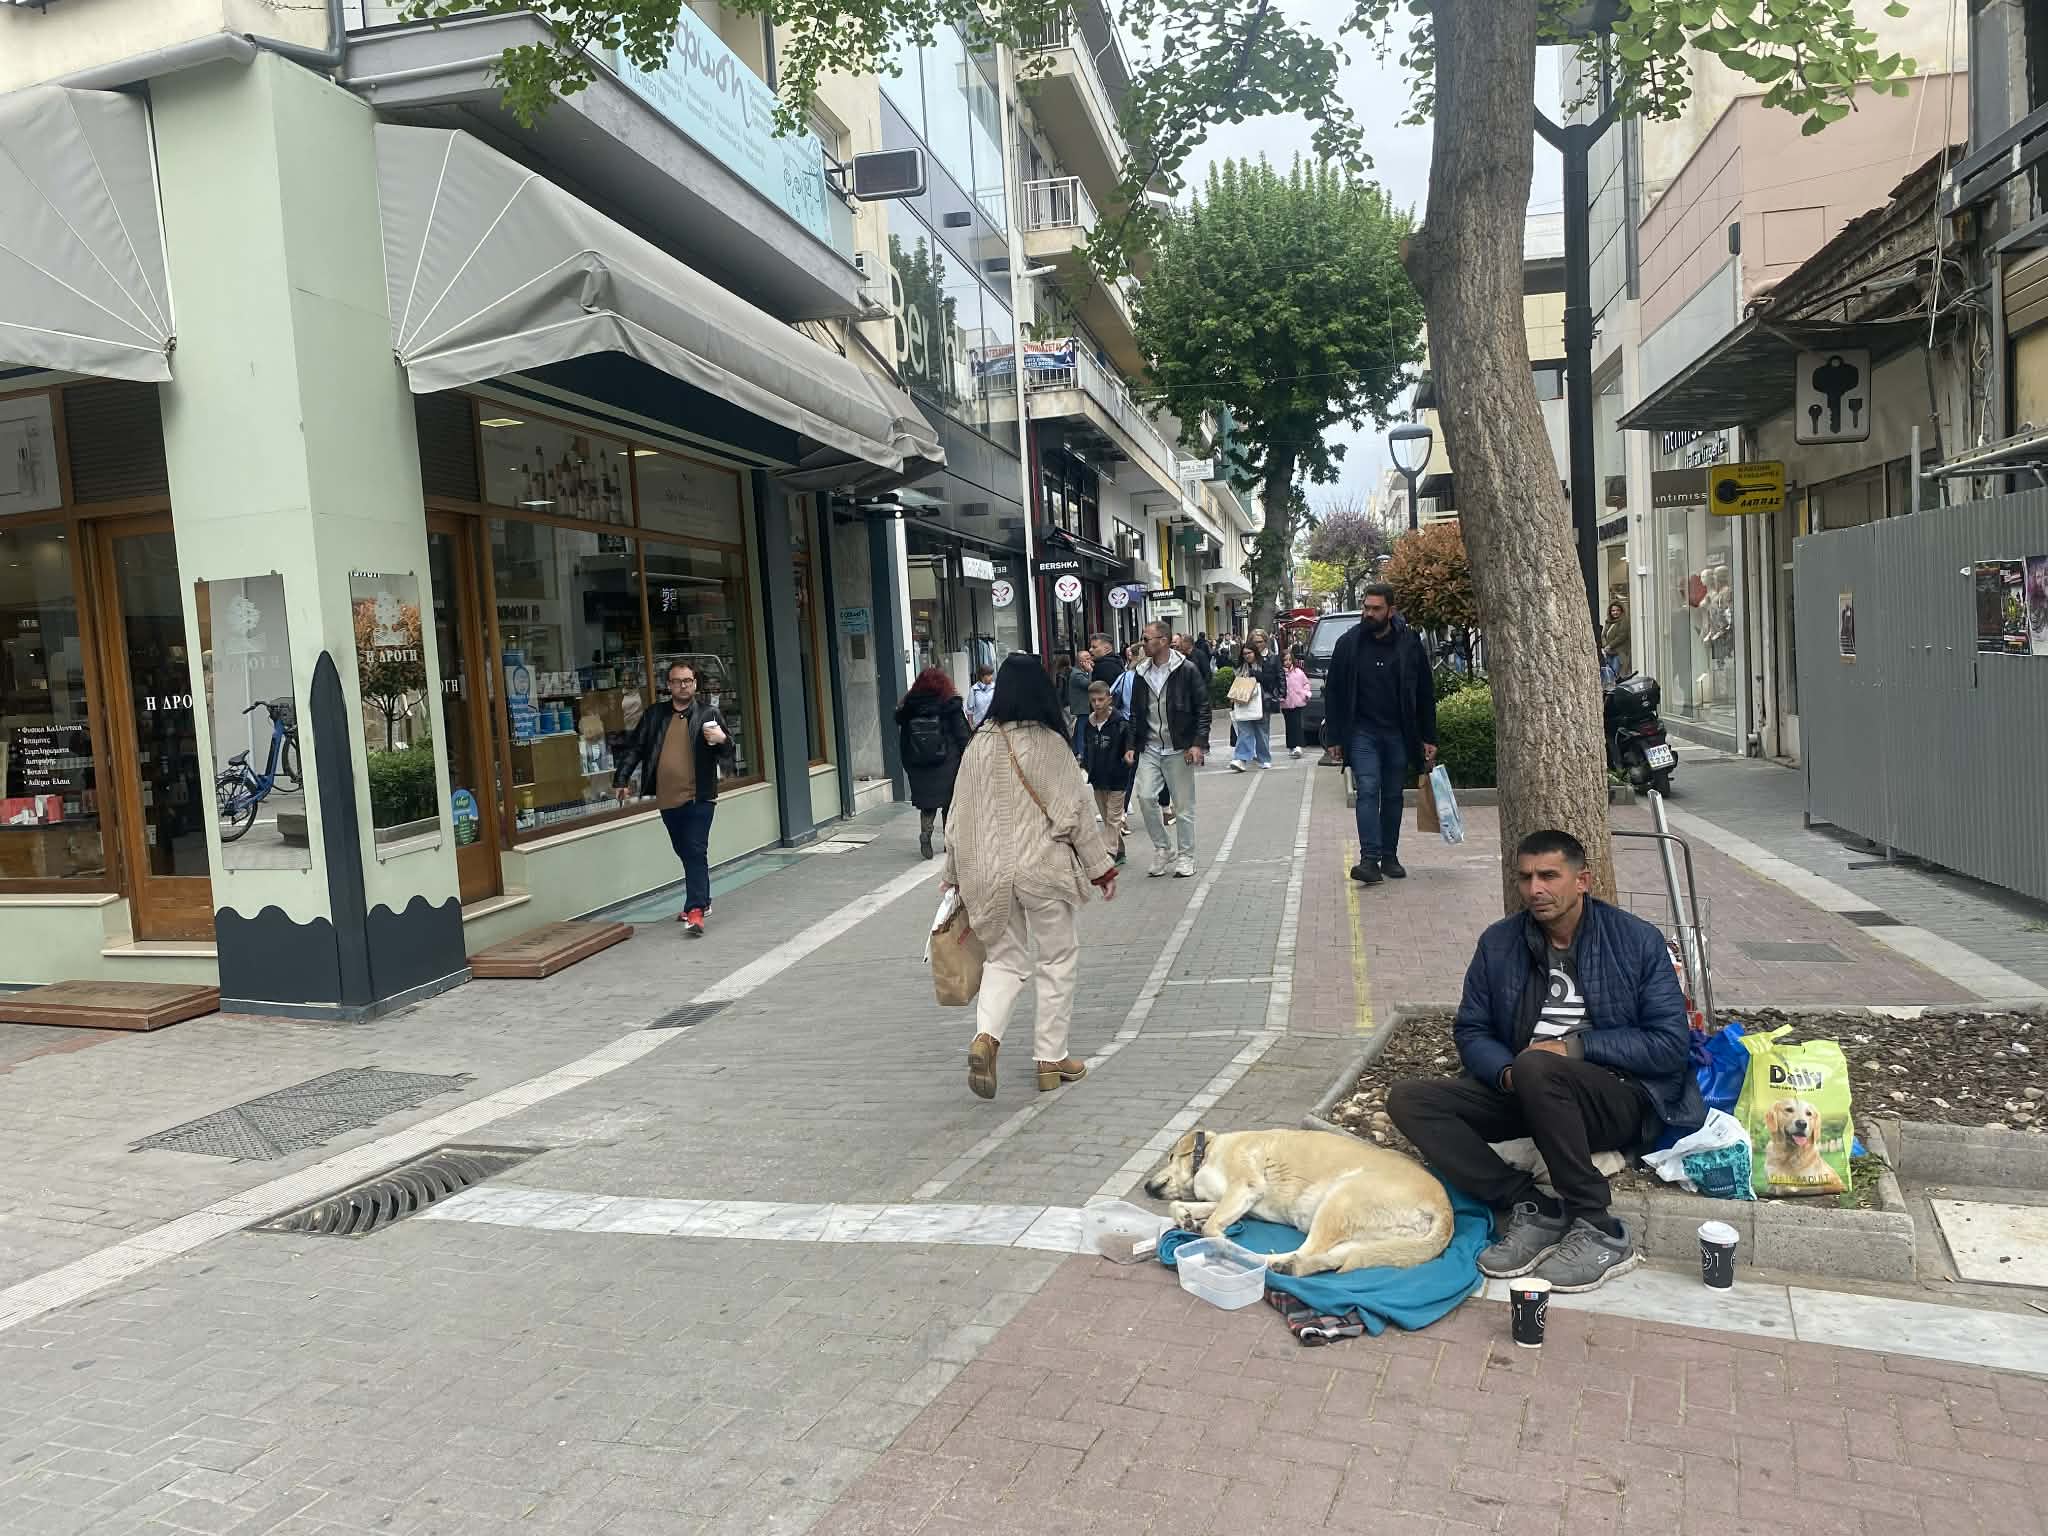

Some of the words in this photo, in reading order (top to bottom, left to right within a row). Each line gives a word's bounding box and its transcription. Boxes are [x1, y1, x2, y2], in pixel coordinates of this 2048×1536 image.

[1655, 491, 1708, 503] intimiss
[1039, 561, 1079, 571] BERSHKA
[145, 696, 157, 711] Η
[163, 694, 193, 710] ΔΡΟ
[1769, 1064, 1822, 1089] Daily
